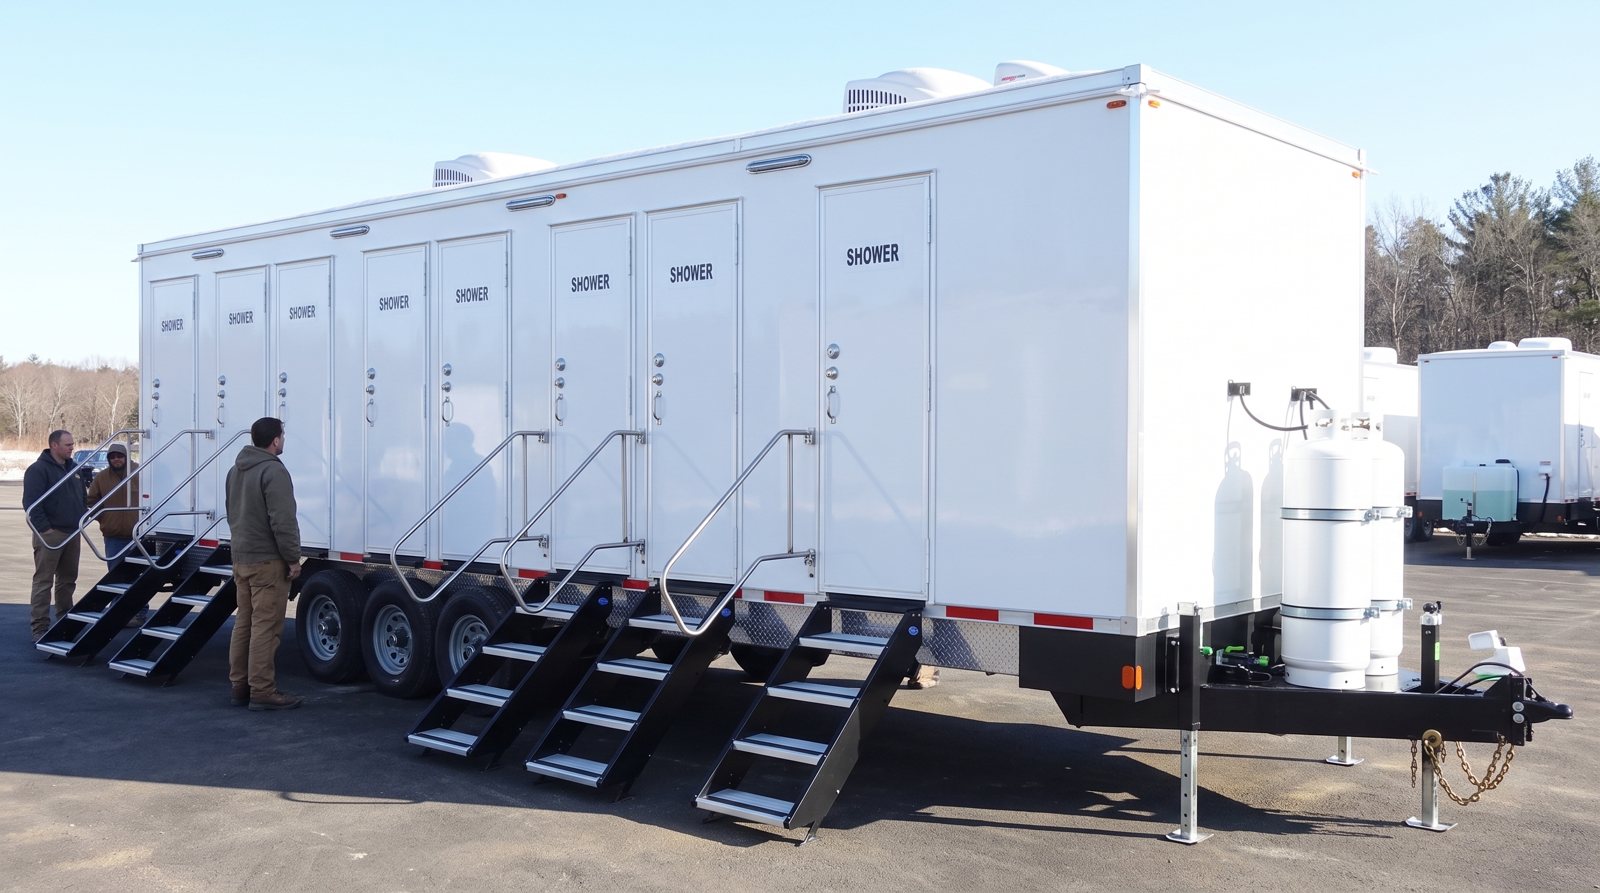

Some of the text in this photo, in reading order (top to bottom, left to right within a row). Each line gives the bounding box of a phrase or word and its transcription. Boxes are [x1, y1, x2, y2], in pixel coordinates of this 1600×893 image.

[847, 244, 899, 266] SHOWER
[670, 263, 713, 283] SHOWER
[571, 274, 610, 292] SHOWER
[456, 286, 489, 303] SHOWER
[379, 295, 409, 311] SHOWER
[229, 311, 253, 325] SHOWER
[289, 305, 316, 319] SHOWER
[161, 319, 184, 333] SHOWER
